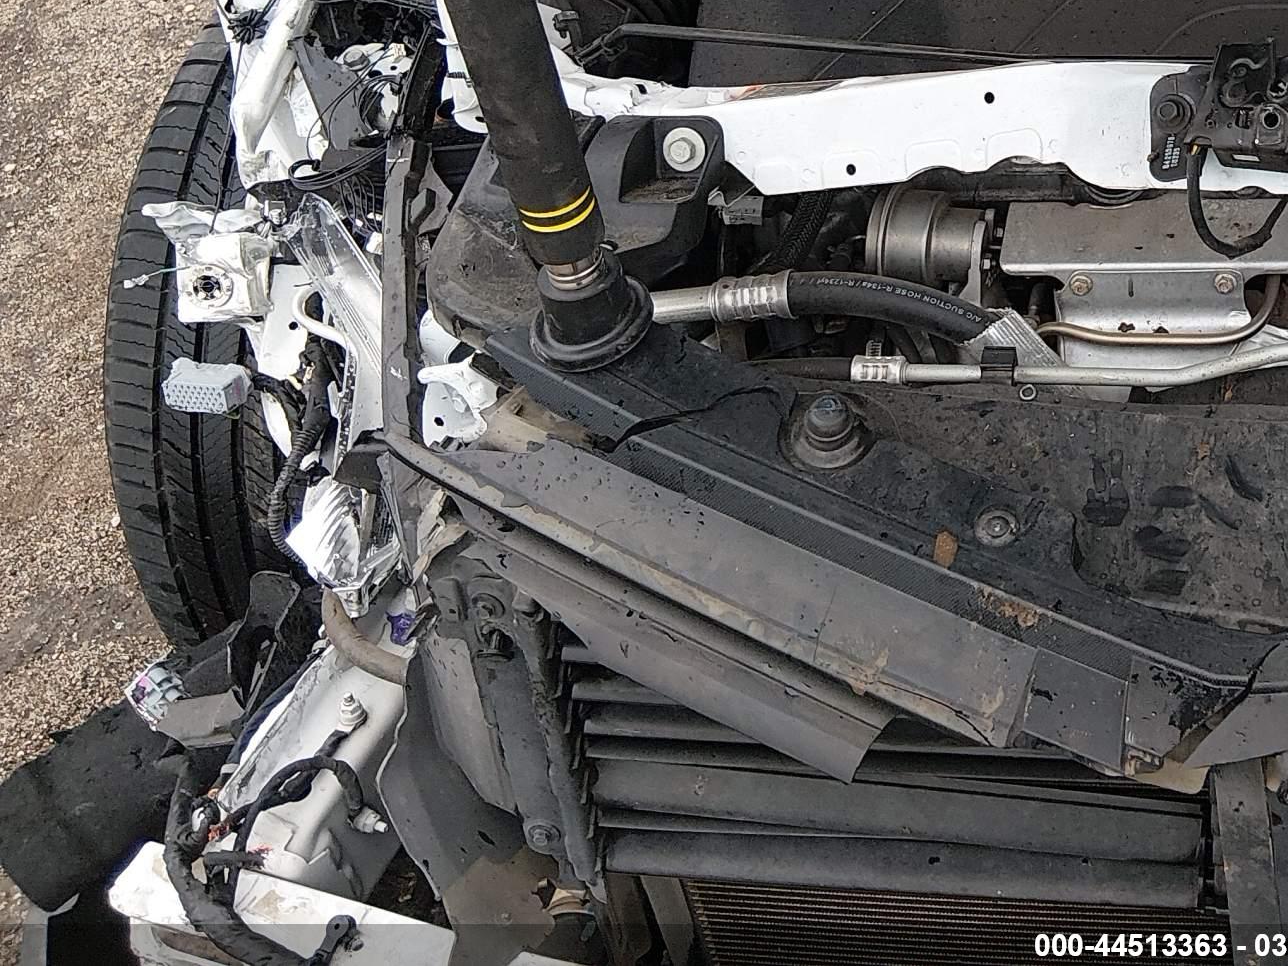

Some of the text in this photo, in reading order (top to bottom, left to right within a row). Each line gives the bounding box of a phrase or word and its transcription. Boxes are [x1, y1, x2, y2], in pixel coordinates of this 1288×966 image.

[861, 280, 894, 292] R-134a
[894, 286, 922, 300] HOSE
[922, 294, 965, 315] SUCTION
[966, 311, 982, 324] A/C
